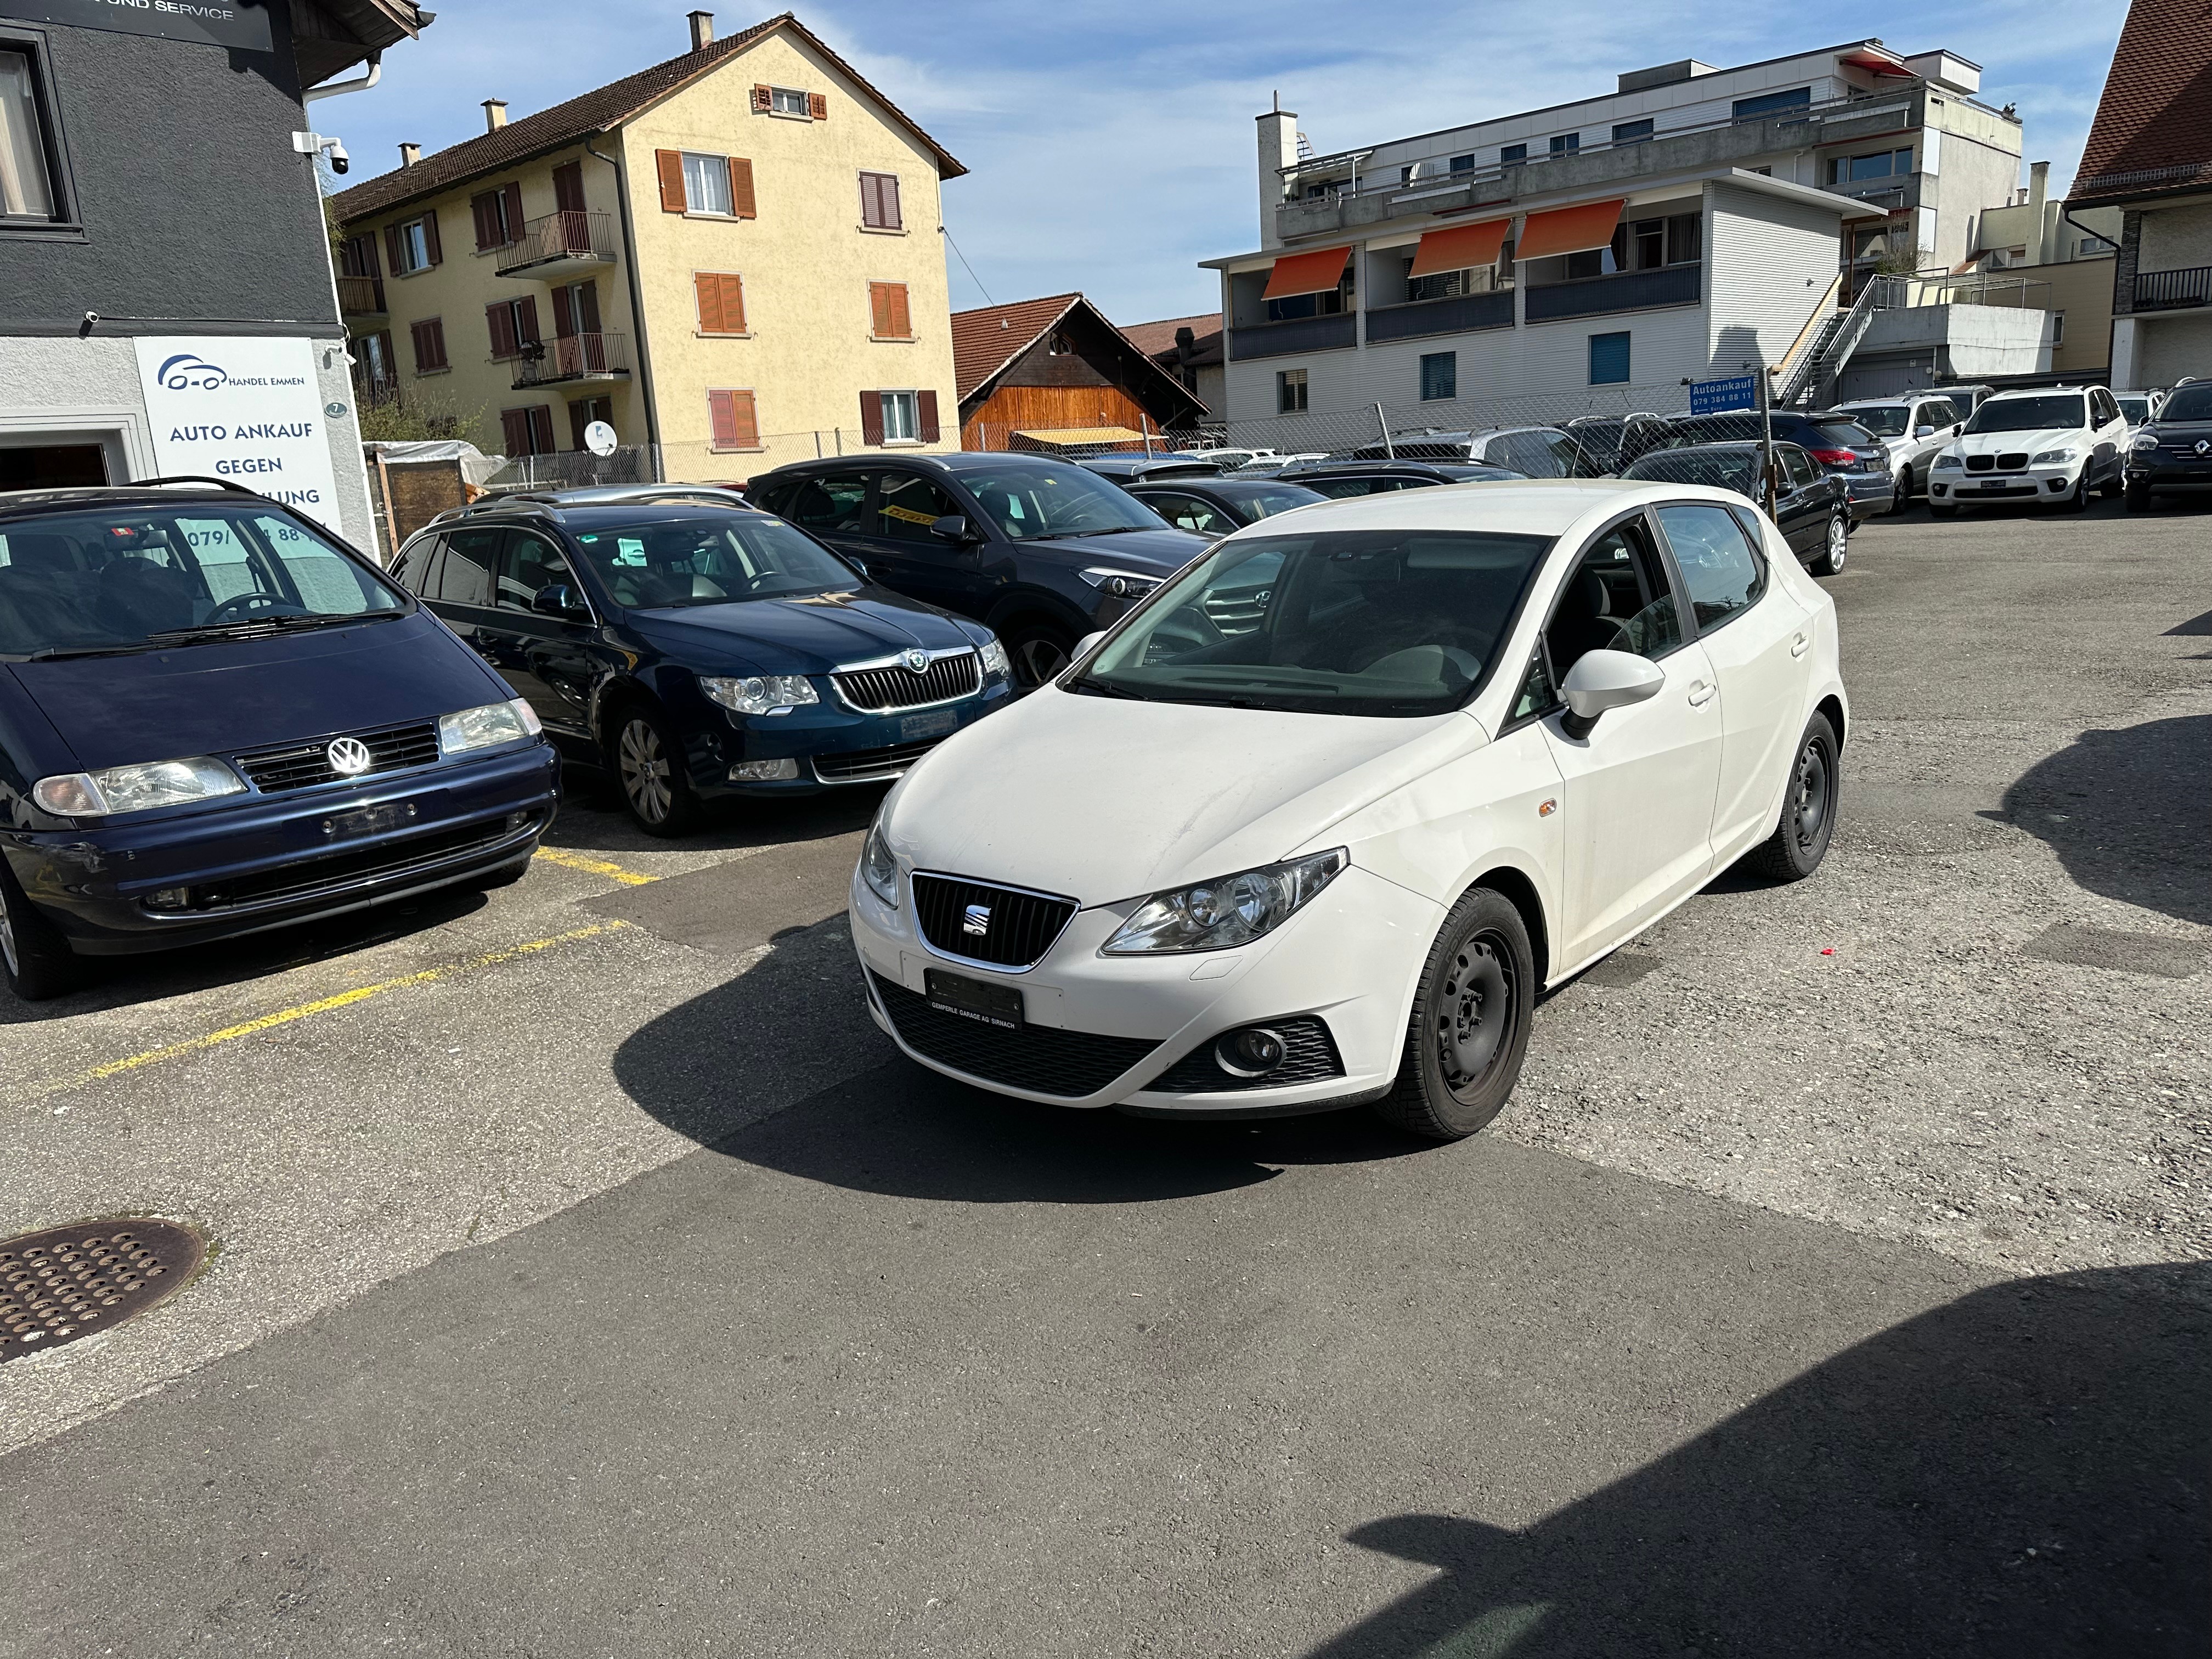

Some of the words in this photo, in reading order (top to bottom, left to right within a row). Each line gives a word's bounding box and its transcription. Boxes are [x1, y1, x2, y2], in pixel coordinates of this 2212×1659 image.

[155, 0, 234, 21] SERVICE
[229, 377, 268, 386] HANDEL
[271, 377, 305, 385] EMMEN
[1693, 379, 1751, 395] Autoankauf
[1711, 395, 1725, 403] 384
[332, 403, 338, 412] 7
[170, 426, 227, 441] AUTO
[234, 423, 312, 439] ANKAUF
[216, 458, 283, 474] GEGEN
[932, 1002, 958, 1014] GEMPERLE
[960, 1009, 981, 1021] GARAGE
[991, 1018, 1015, 1029] SIRNACH
